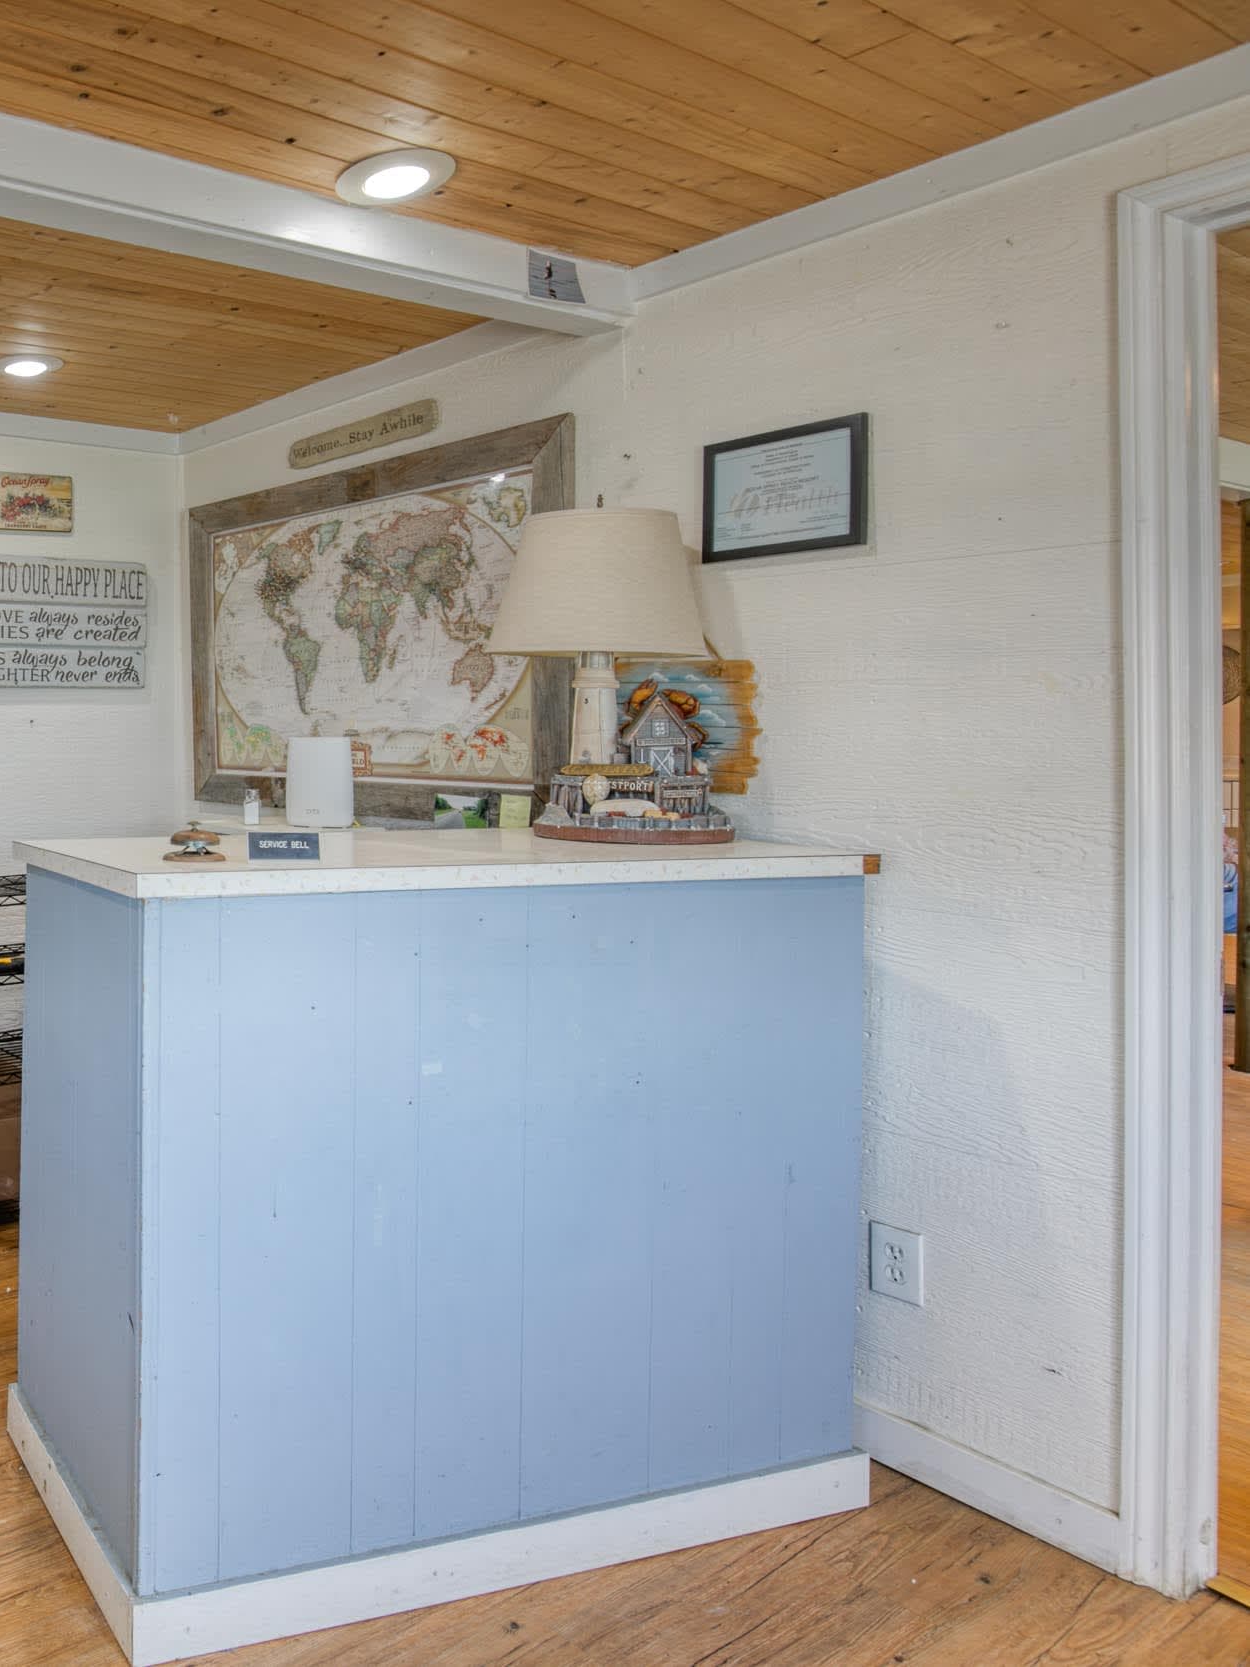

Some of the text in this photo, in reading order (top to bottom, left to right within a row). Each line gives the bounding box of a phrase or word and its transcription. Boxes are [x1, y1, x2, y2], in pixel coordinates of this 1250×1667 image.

[380, 413, 424, 436] Awhile
[0, 561, 18, 594] TO
[22, 563, 51, 595] OUR
[54, 566, 101, 597] HAPPY
[104, 569, 145, 600] PLACE
[30, 608, 79, 629] always
[36, 626, 65, 641] are
[73, 626, 141, 642] created
[12, 649, 67, 672] always
[54, 667, 98, 683] never
[105, 667, 140, 684] ends
[259, 840, 310, 849] SERVICE BELL
